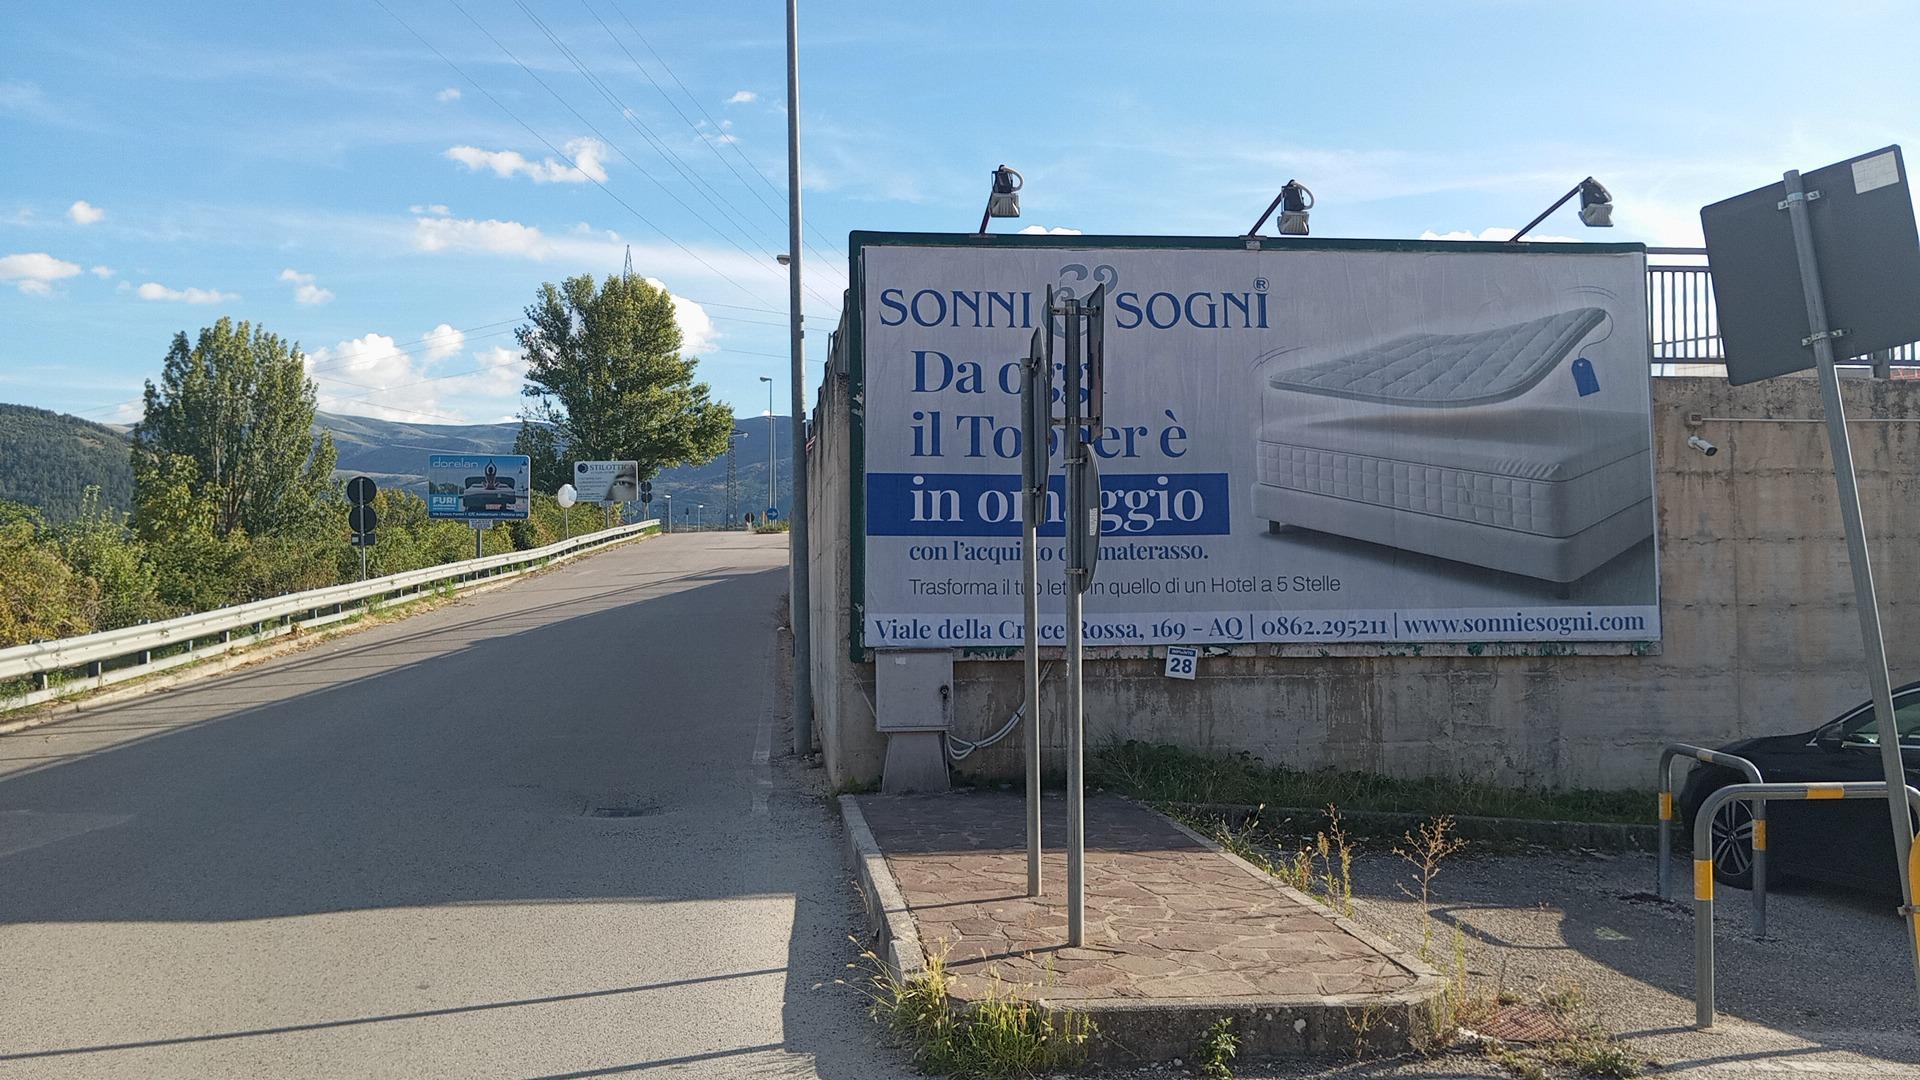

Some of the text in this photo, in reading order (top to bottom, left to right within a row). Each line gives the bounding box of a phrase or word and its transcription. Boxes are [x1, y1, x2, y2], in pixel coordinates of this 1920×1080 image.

[879, 288, 1033, 329] SONNI
[1114, 292, 1271, 330] SOGNI
[911, 349, 986, 395] Da
[910, 409, 1188, 469] il Toer è
[432, 456, 479, 469] dorelan
[589, 463, 636, 472] STILOTTICA
[432, 496, 457, 505] FURI
[910, 475, 964, 523] in
[977, 476, 1204, 534] omggio
[909, 545, 948, 561] con
[953, 541, 1053, 566] l’acquio
[1098, 542, 1209, 561] materasso.
[909, 578, 998, 596] Trasforma
[1002, 578, 1010, 596] il
[1090, 581, 1105, 596] in
[1109, 578, 1161, 598] quello
[1165, 577, 1181, 595] di
[1185, 581, 1207, 594] un
[1211, 576, 1257, 593] Hotel
[1261, 580, 1274, 593] a
[1277, 576, 1289, 592] 5
[1292, 575, 1342, 592] Stelle
[875, 618, 932, 640] Viale
[938, 618, 992, 640] della
[999, 619, 1065, 640] Crce
[1152, 617, 1186, 640] 169
[1208, 616, 1244, 640] AQ
[1261, 615, 1388, 639] 0862.295211
[1403, 611, 1646, 636] www.sonniesogni.com
[1170, 657, 1193, 674] 28
